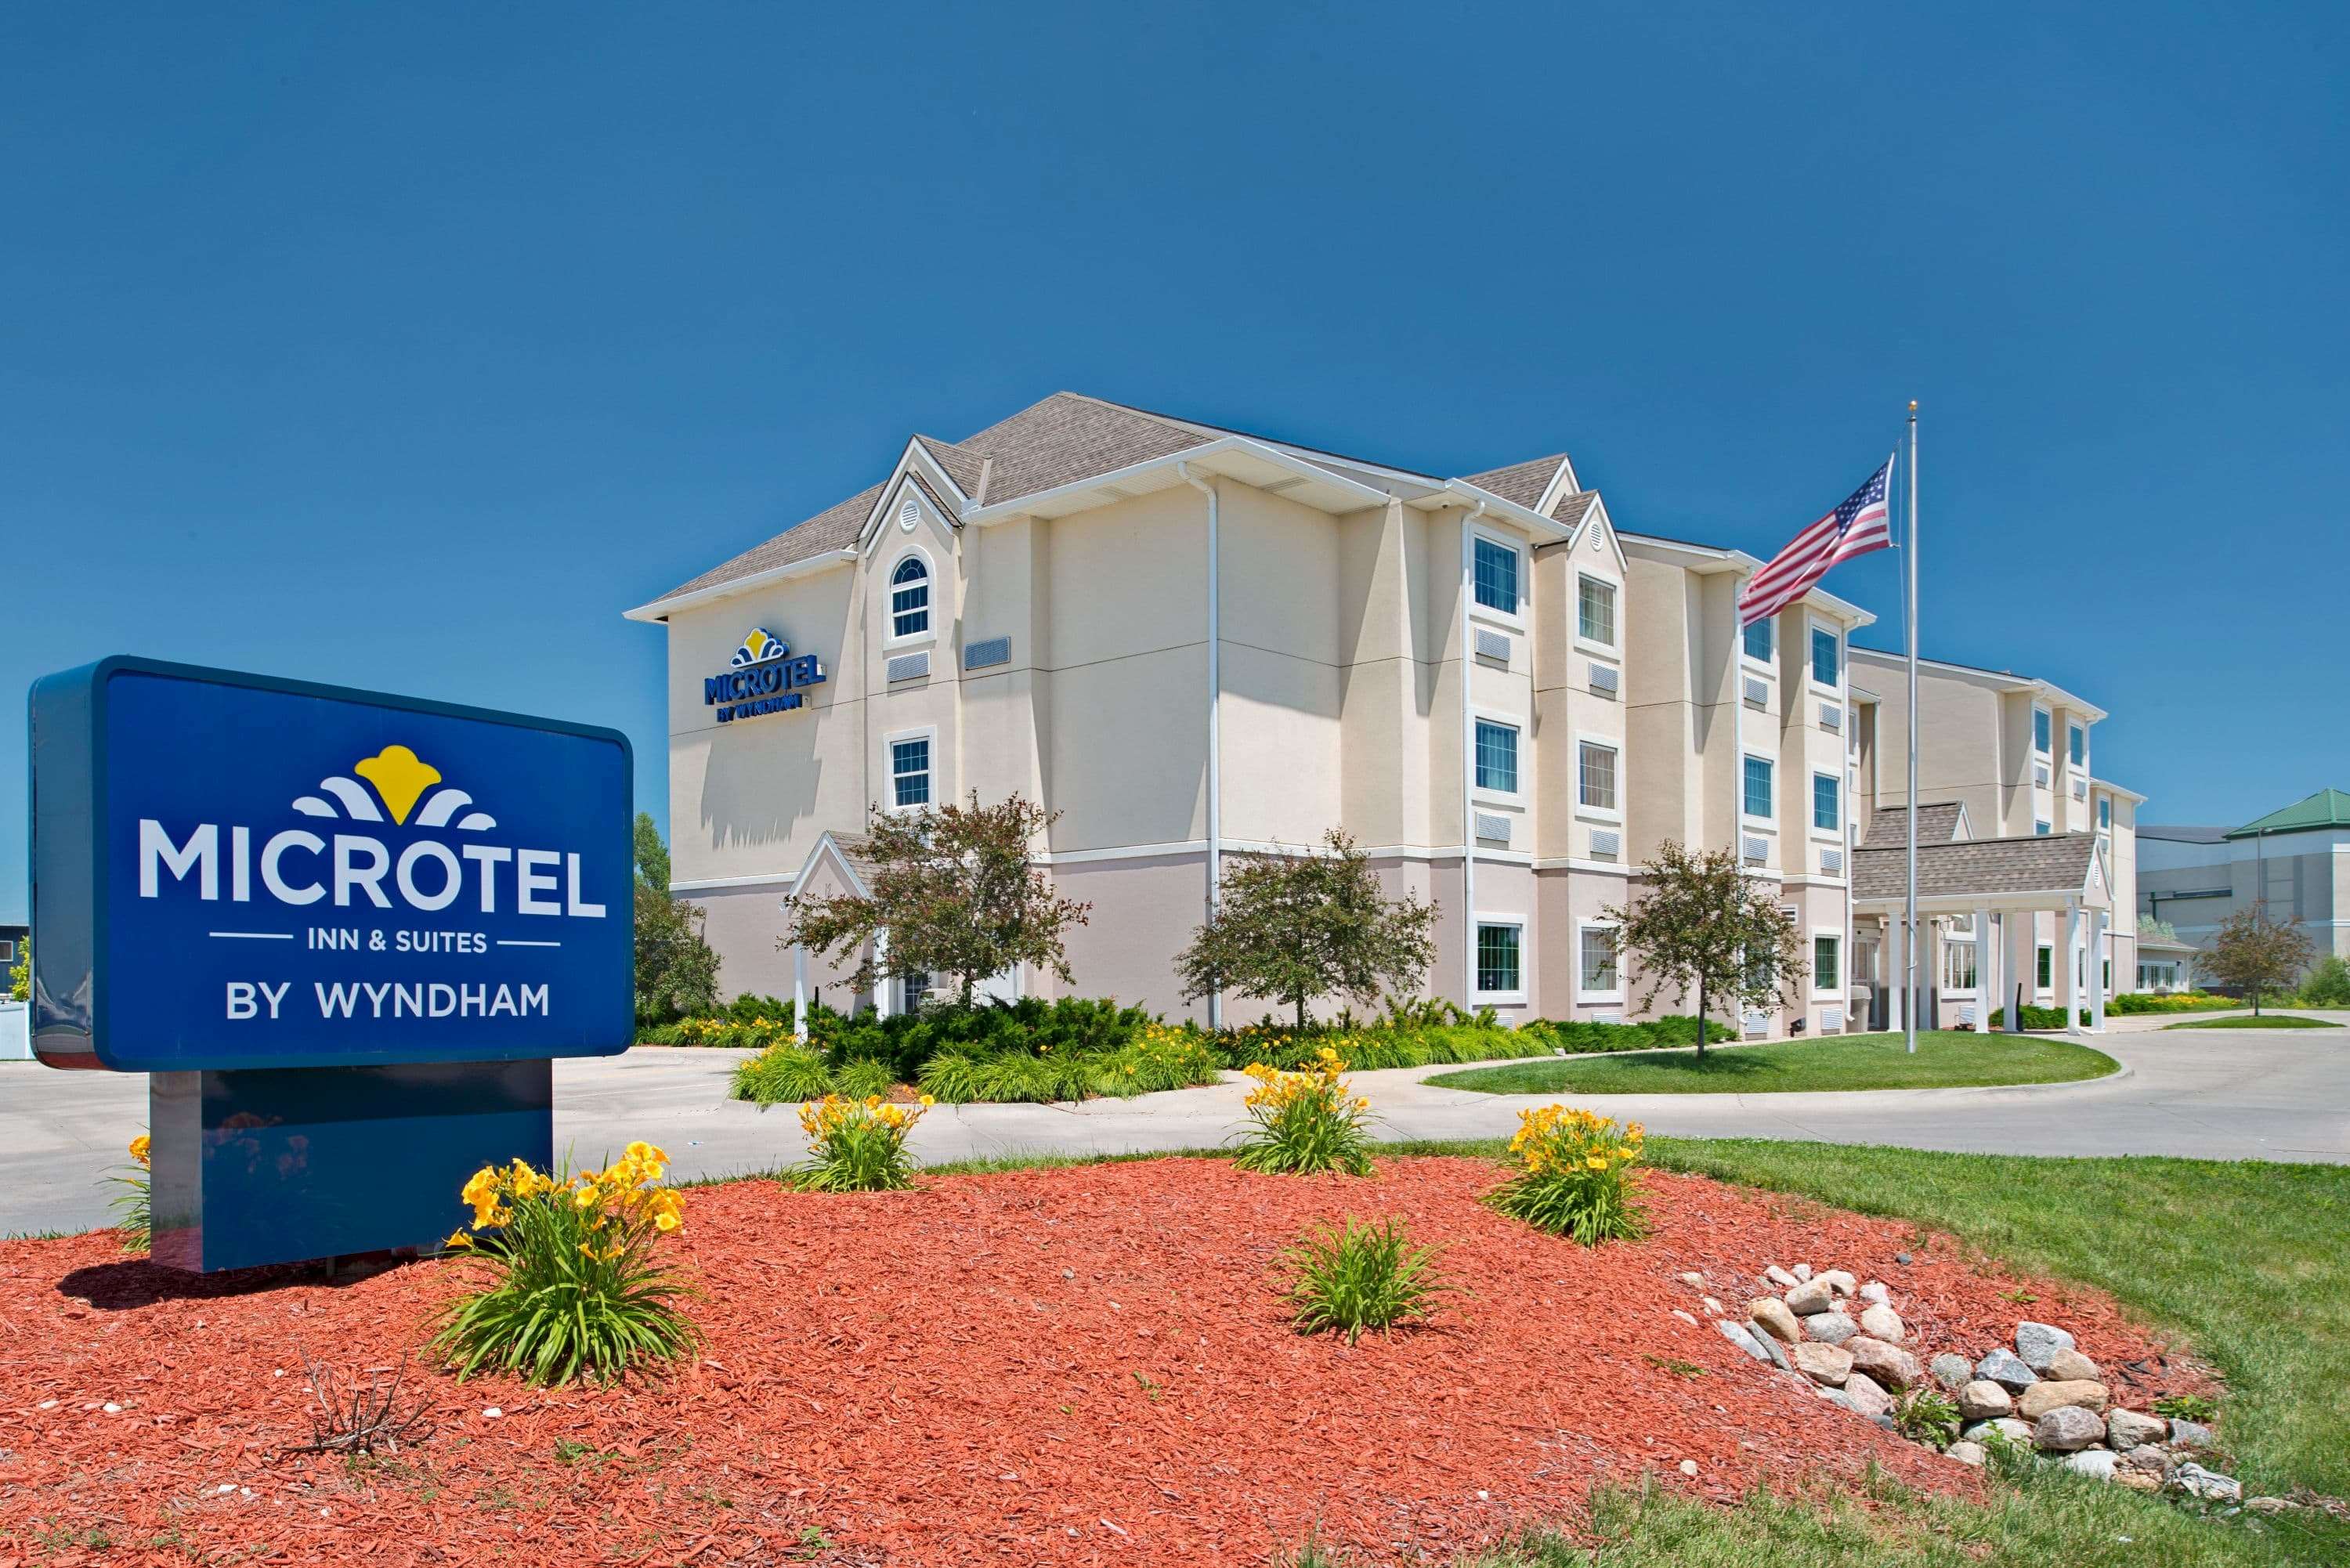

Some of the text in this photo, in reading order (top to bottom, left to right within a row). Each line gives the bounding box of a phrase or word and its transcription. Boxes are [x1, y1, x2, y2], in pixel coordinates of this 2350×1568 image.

[704, 655, 826, 705] MICROTEL
[717, 706, 736, 722] BY
[139, 819, 606, 918] MICROTEL
[309, 927, 487, 953] INN & SUITES
[227, 982, 549, 1019] BY WYNDHAM
